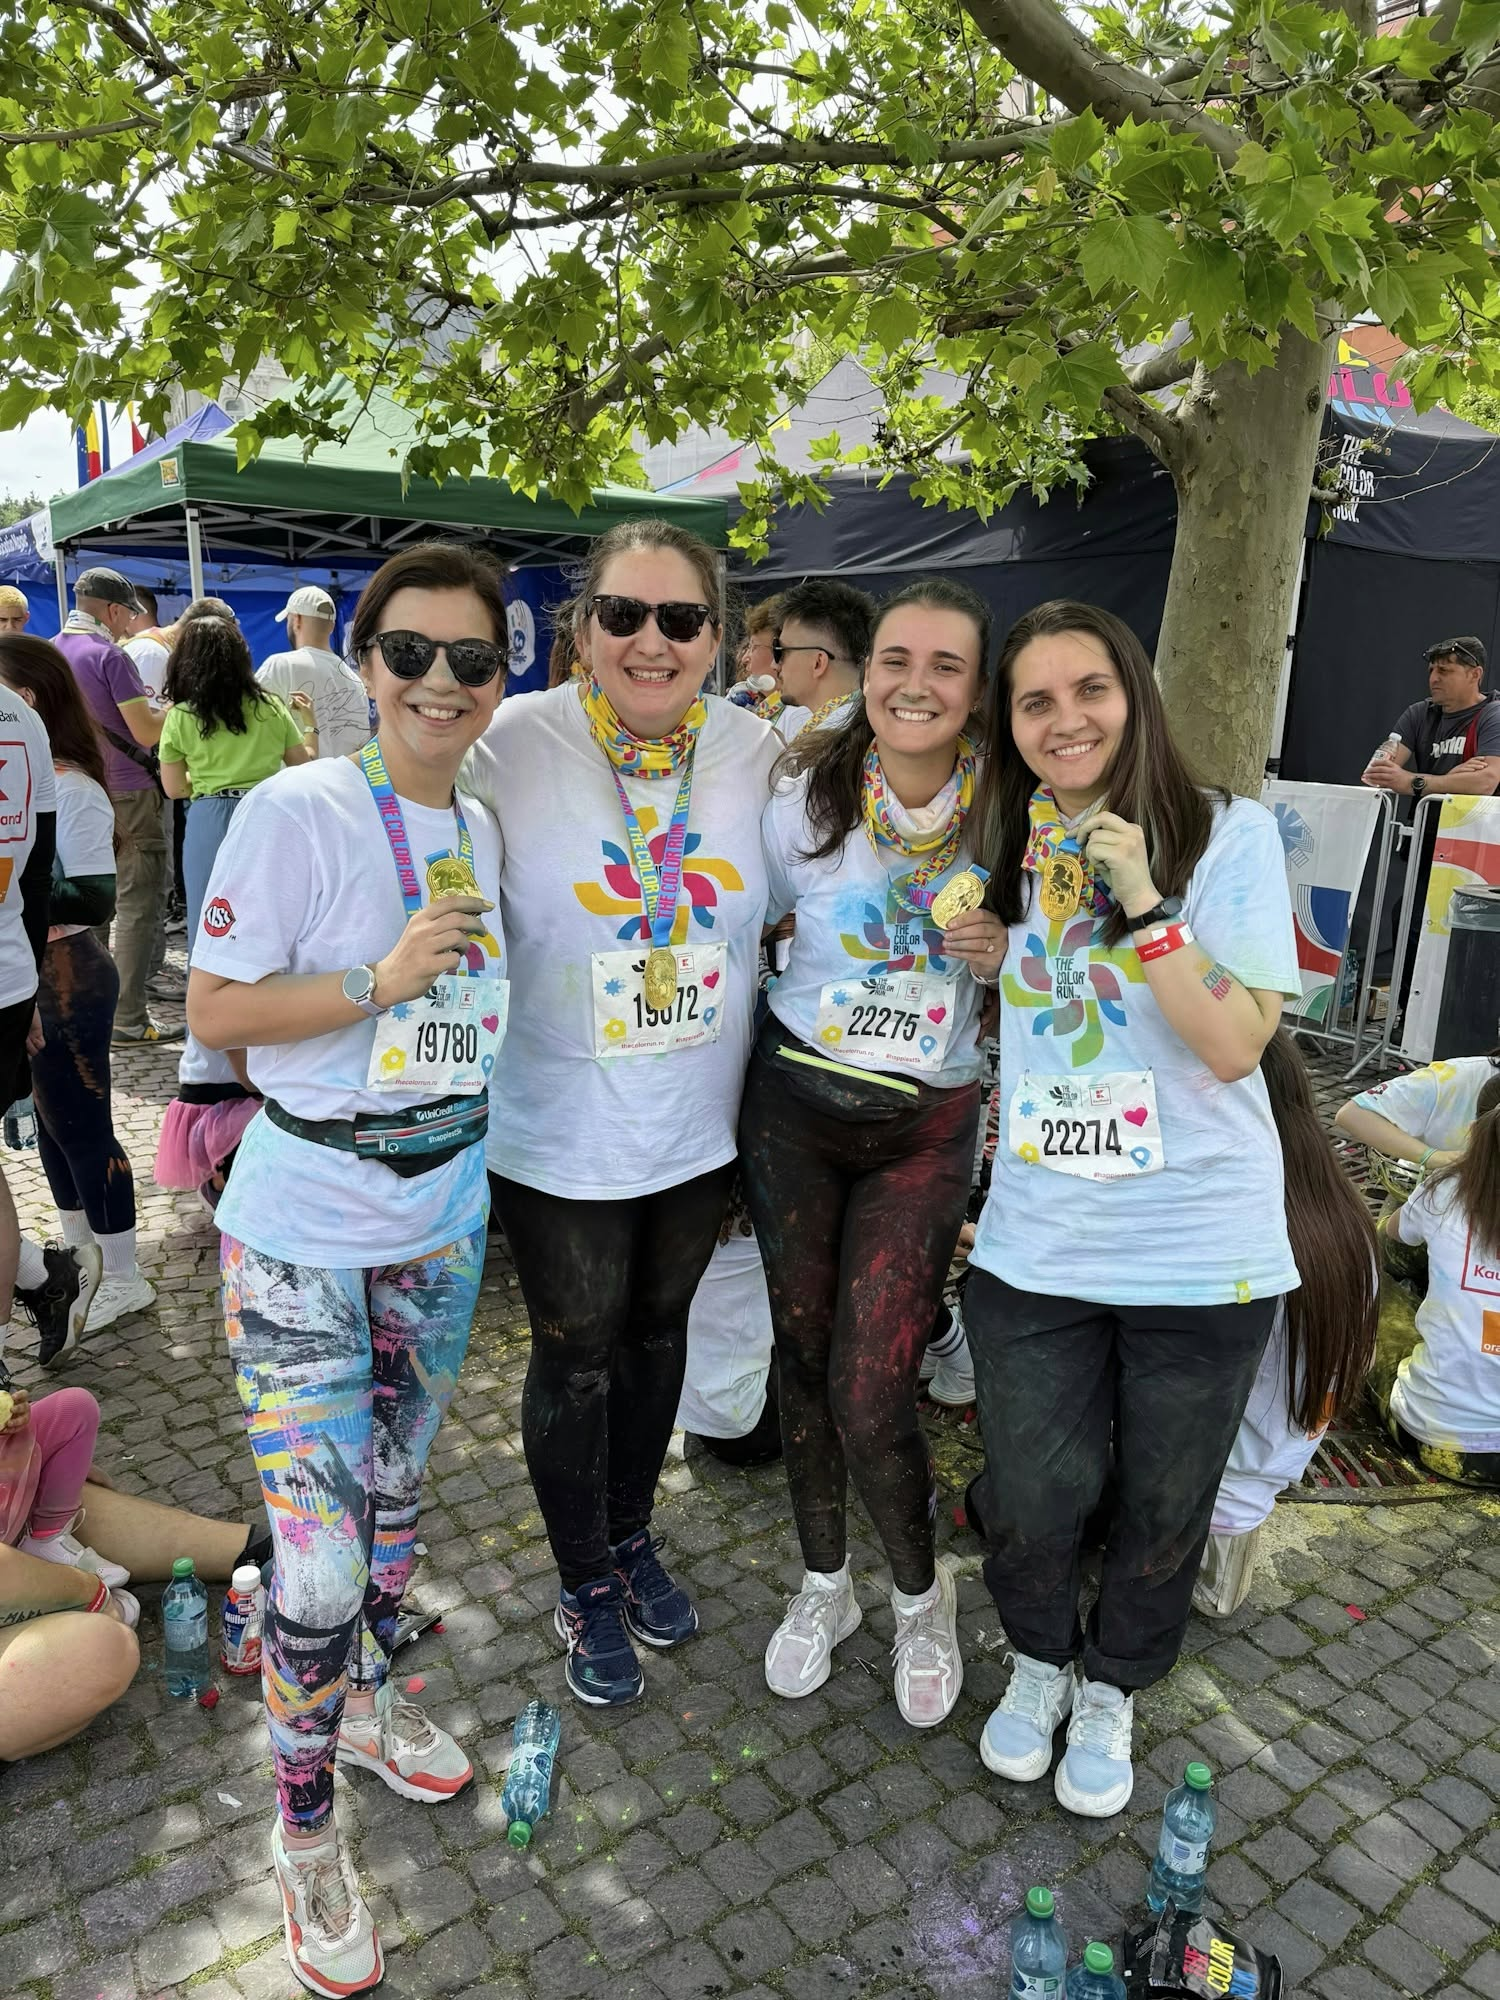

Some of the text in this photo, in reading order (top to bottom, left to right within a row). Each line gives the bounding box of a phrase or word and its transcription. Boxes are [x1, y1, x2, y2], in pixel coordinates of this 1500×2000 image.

[365, 757, 389, 787] RUN
[674, 791, 689, 815] THE
[376, 794, 420, 897] THE COLOR RUN
[629, 825, 643, 850] THE
[636, 849, 660, 894] COLOR
[657, 824, 685, 919] THE COLOR RUN
[894, 935, 919, 945] COLOR
[895, 924, 909, 934] THE
[1055, 957, 1074, 971] THE
[875, 983, 894, 993] COLOR
[1057, 971, 1085, 985] COLOR
[847, 1005, 920, 1042] 22275
[415, 1021, 478, 1064] 19780
[425, 1104, 454, 1120] UniCredit
[428, 1126, 463, 1144] #happiest5k
[1041, 1118, 1122, 1156] 22274
[1206, 1938, 1235, 1993] COLOR
